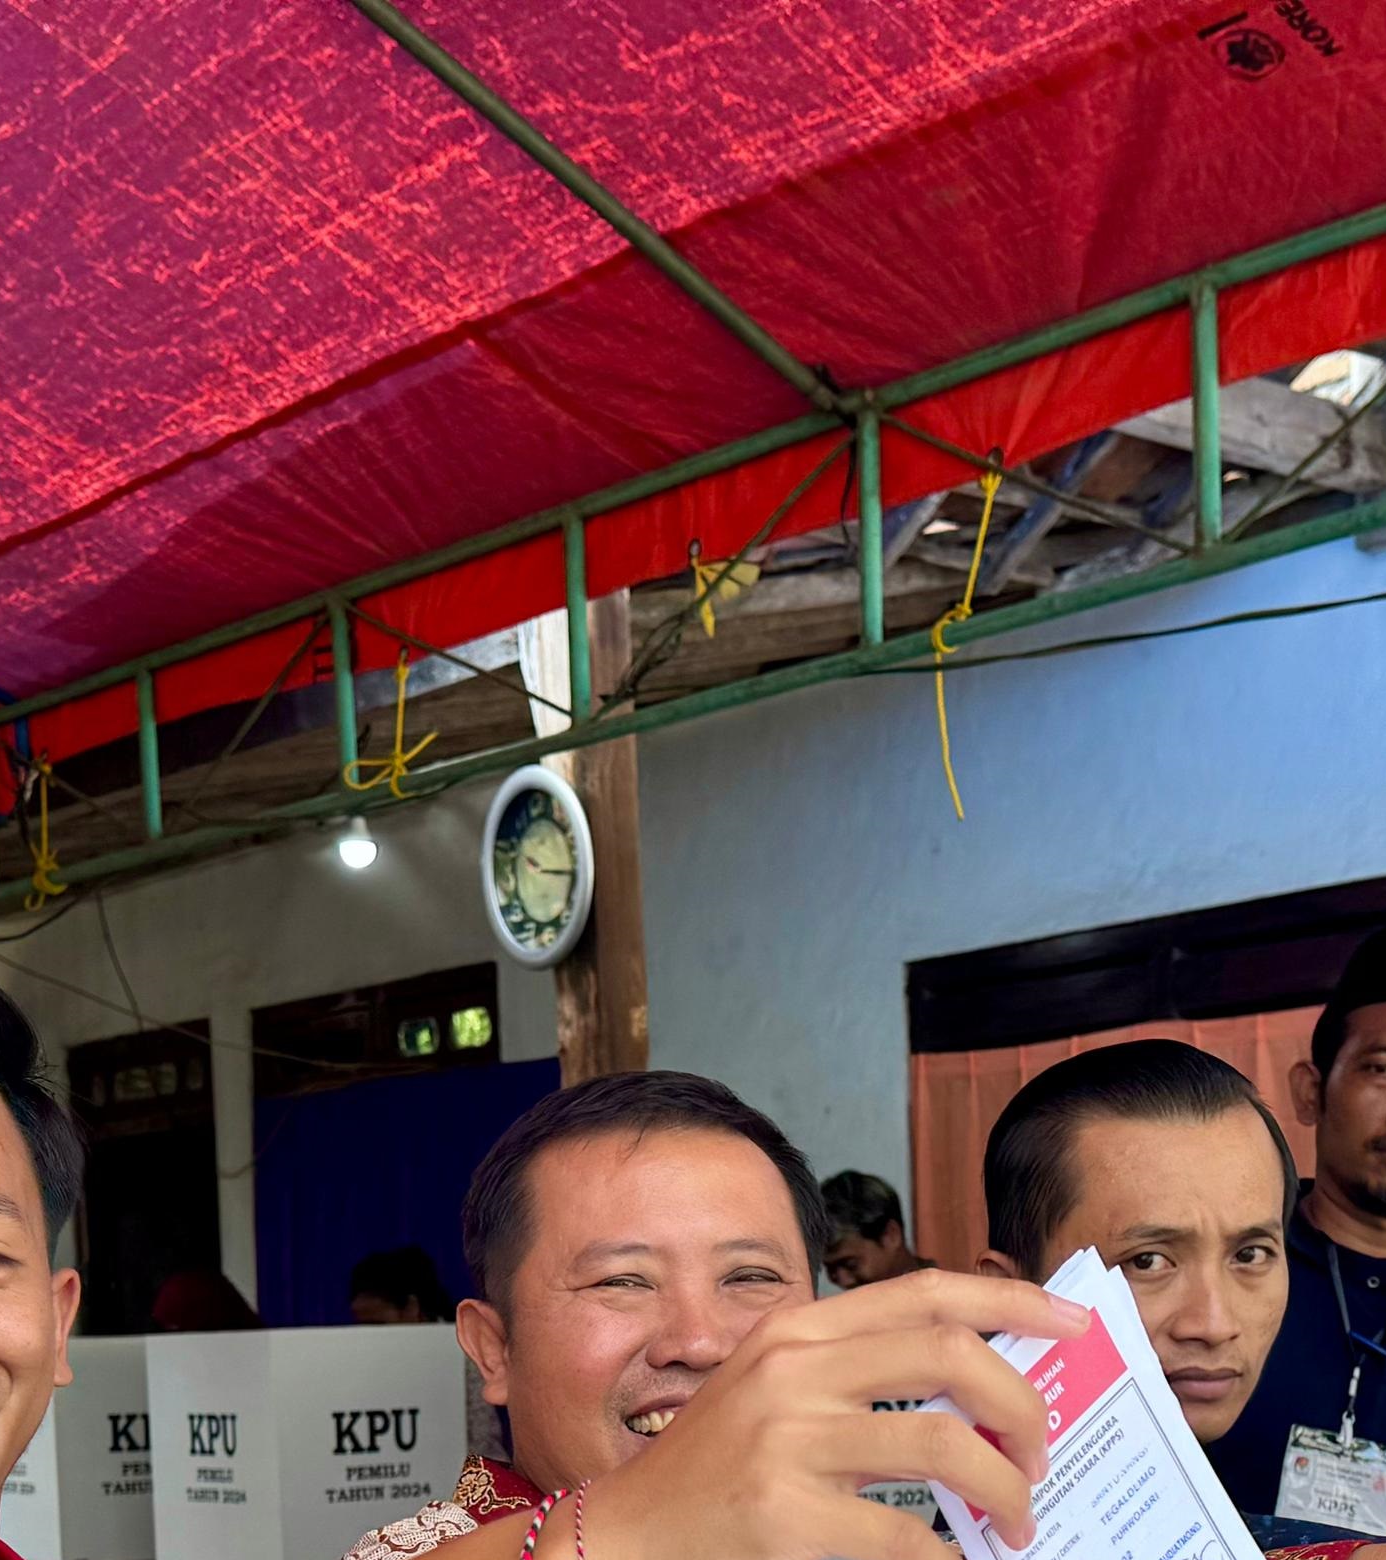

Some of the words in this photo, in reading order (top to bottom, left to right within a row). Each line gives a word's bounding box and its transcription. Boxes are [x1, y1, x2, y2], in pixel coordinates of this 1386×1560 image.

[1035, 1358, 1064, 1392] ILIHAN
[187, 1412, 238, 1458] KPU
[331, 1408, 421, 1456] KPU
[1056, 1415, 1117, 1481] PENYELENGGARA
[1074, 1453, 1099, 1482] SUARA
[1099, 1428, 1124, 1457] (KPPS)
[325, 1486, 385, 1504] TAHUN
[390, 1482, 432, 1500] 2024
[345, 1463, 411, 1482] PEMILU
[1111, 1492, 1160, 1545] PURWOASRI
[1317, 1497, 1357, 1518] KPPS
